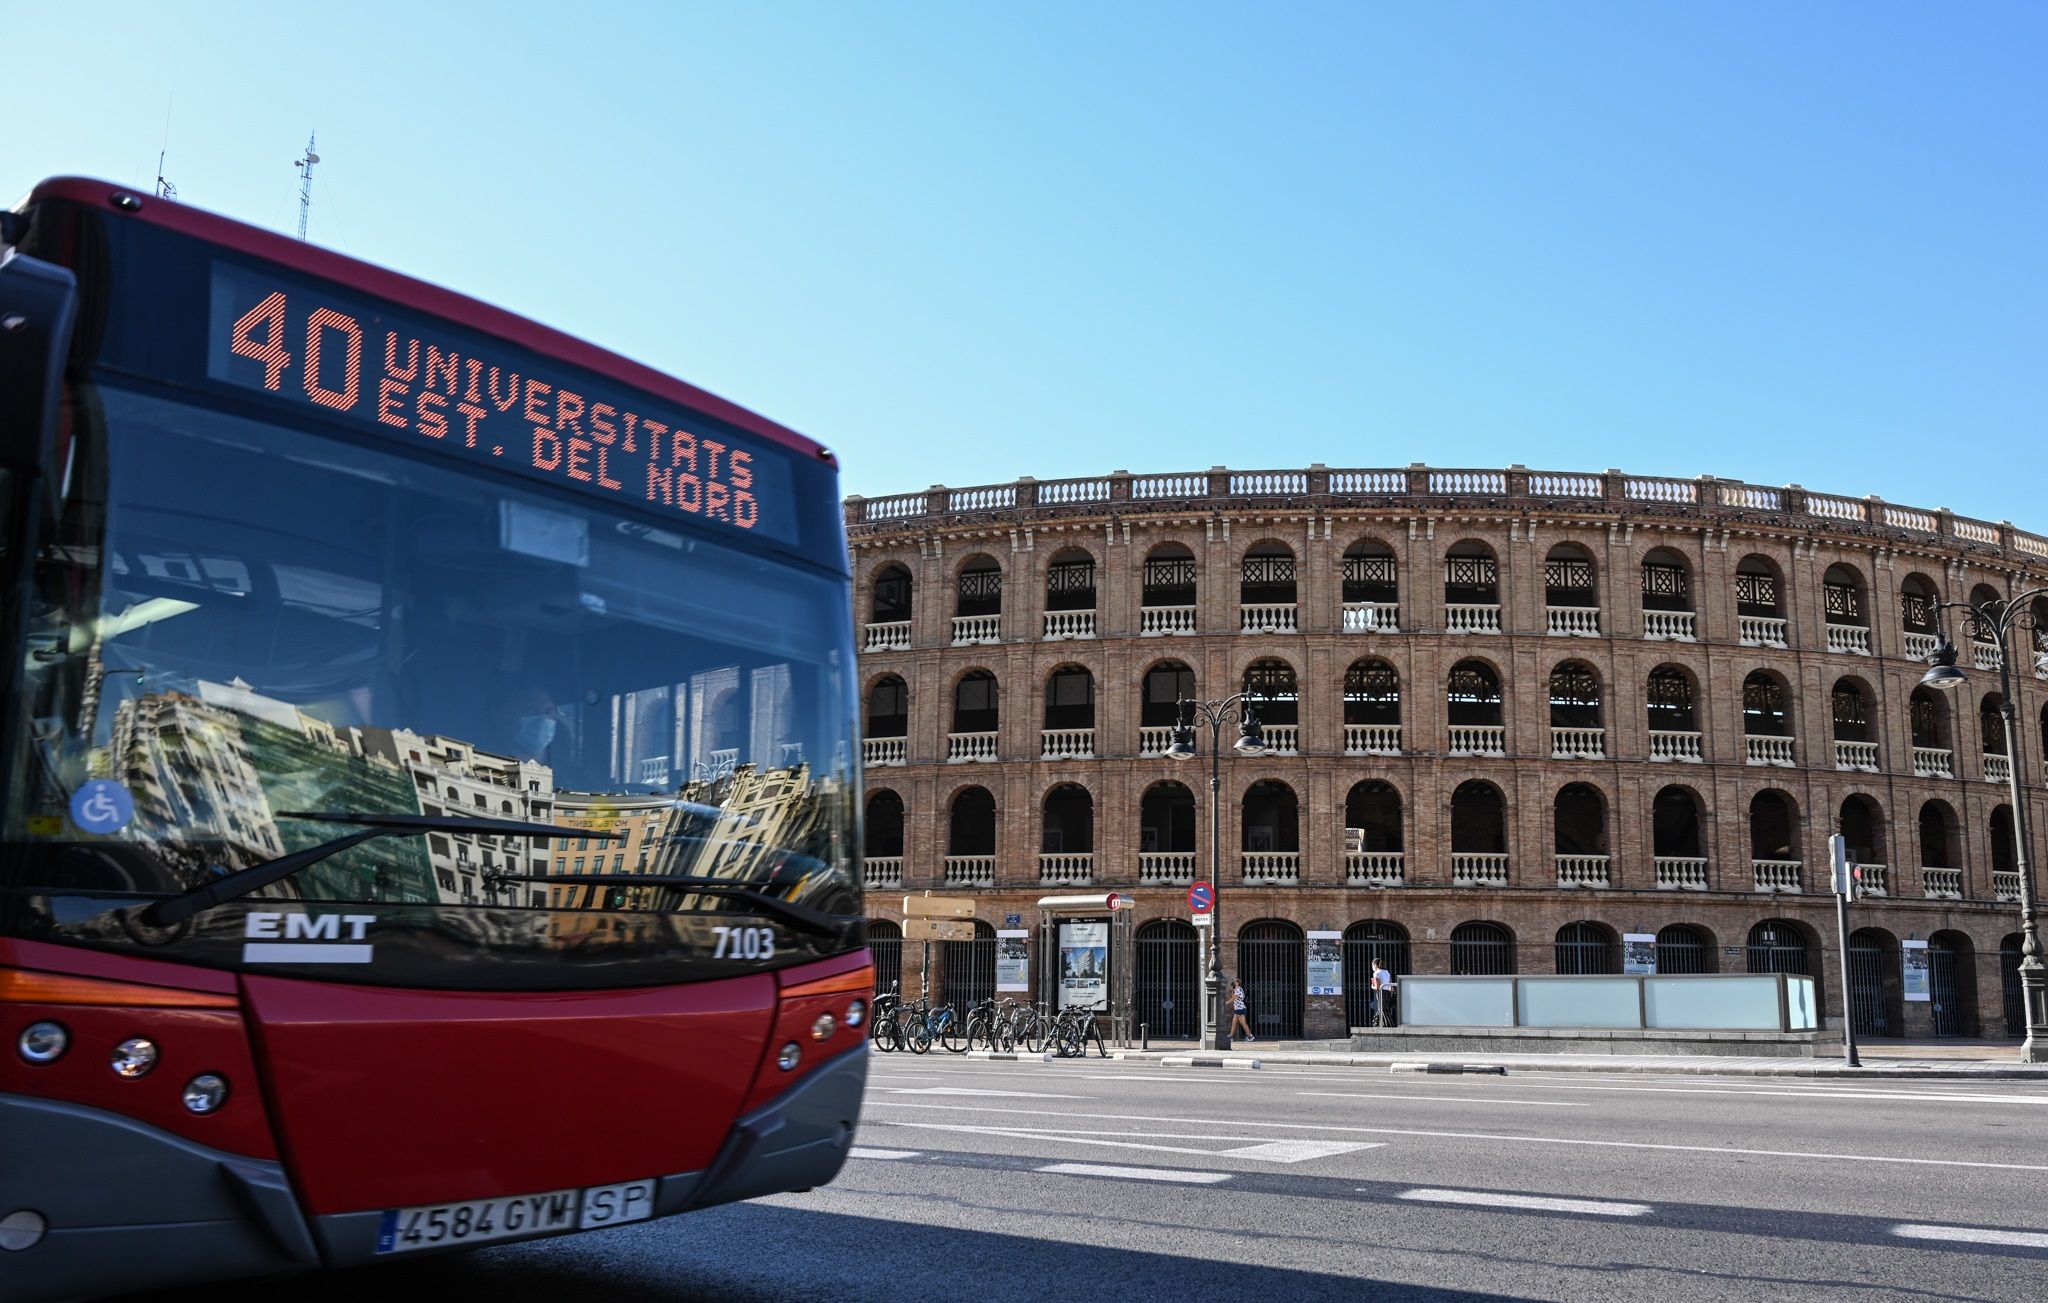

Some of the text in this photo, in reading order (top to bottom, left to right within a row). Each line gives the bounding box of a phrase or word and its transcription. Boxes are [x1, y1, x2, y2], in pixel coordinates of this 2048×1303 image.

[231, 291, 363, 412] 40
[384, 331, 753, 490] UNIVERSITATS
[378, 377, 758, 529] EST. DEL NORD
[244, 911, 377, 941] EMT
[711, 925, 776, 961] 7103
[402, 1203, 495, 1245] 4584
[590, 1185, 647, 1222] SP
